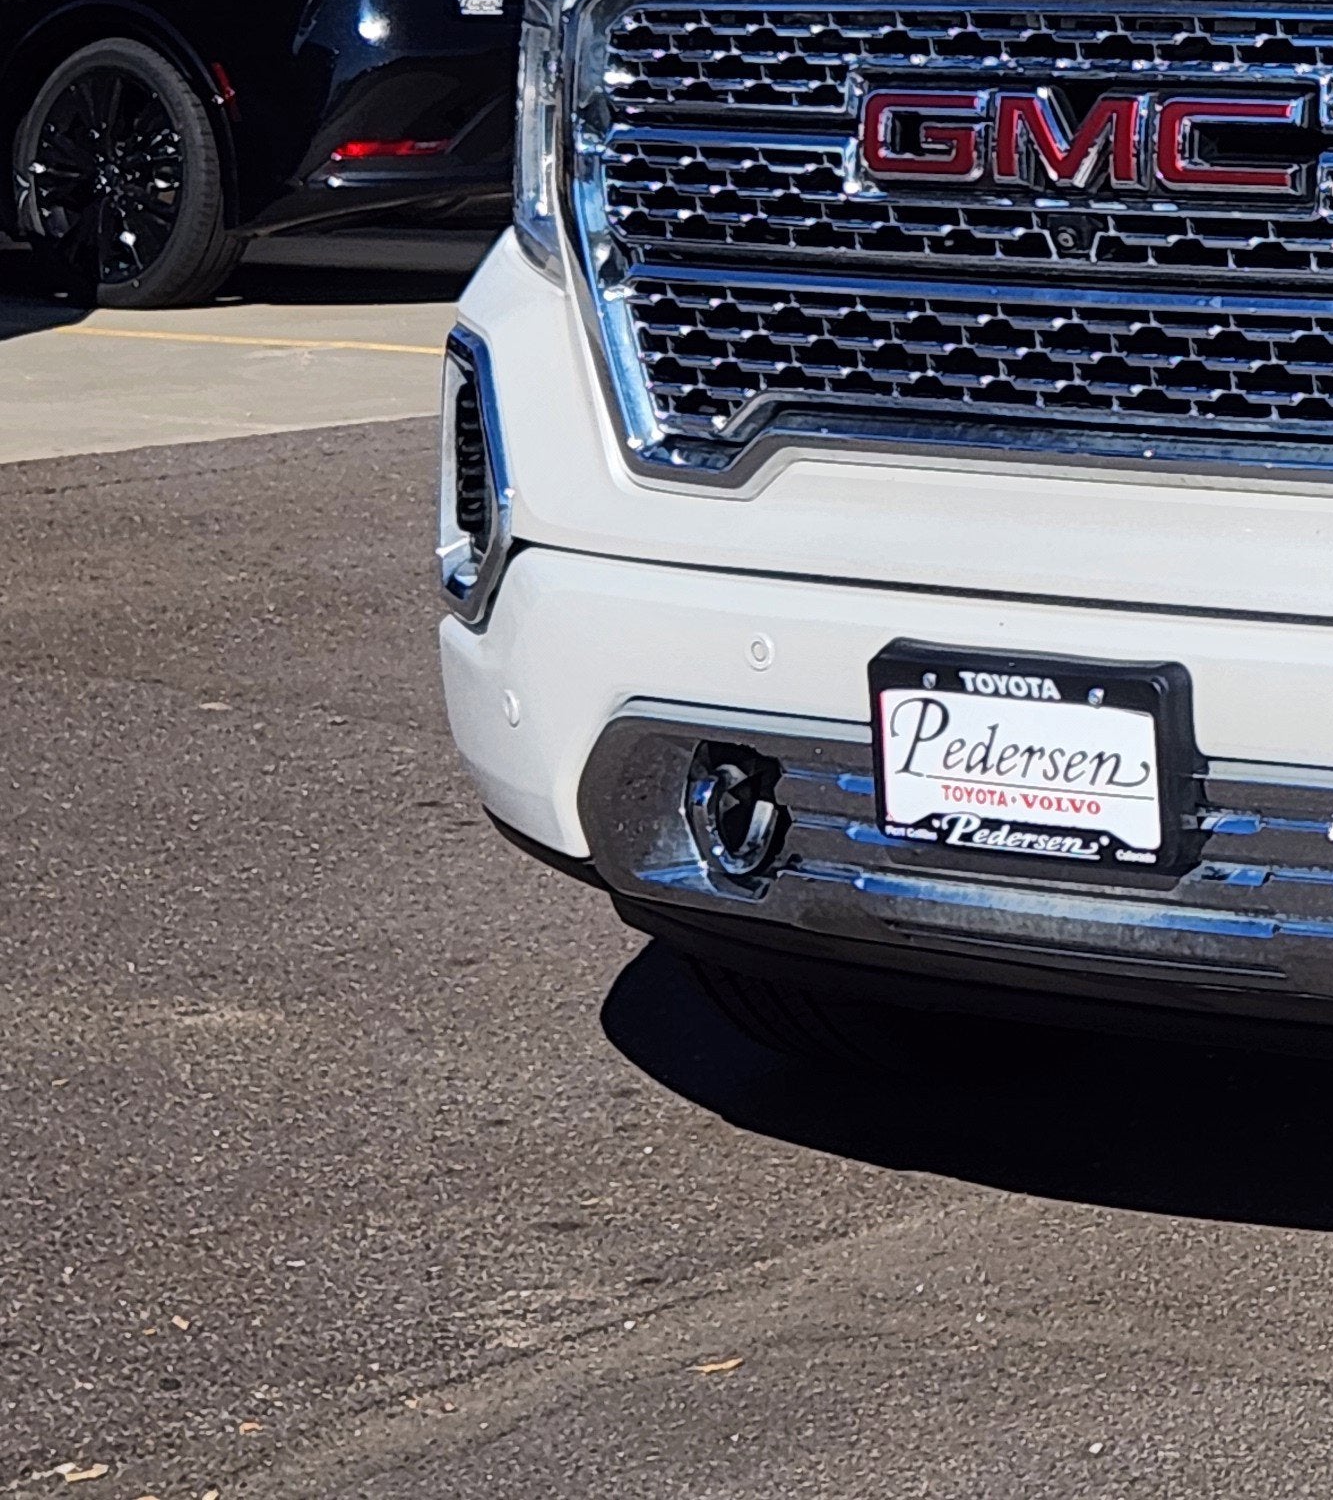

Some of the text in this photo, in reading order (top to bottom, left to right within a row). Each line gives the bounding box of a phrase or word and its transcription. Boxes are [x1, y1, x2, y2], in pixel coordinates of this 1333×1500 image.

[863, 88, 1303, 194] GMC
[958, 671, 1061, 700] TOYOTA
[890, 697, 1152, 788] Pedersen
[941, 784, 1101, 815] TOYOTA VOLVO
[941, 811, 1099, 855] Pedersen
